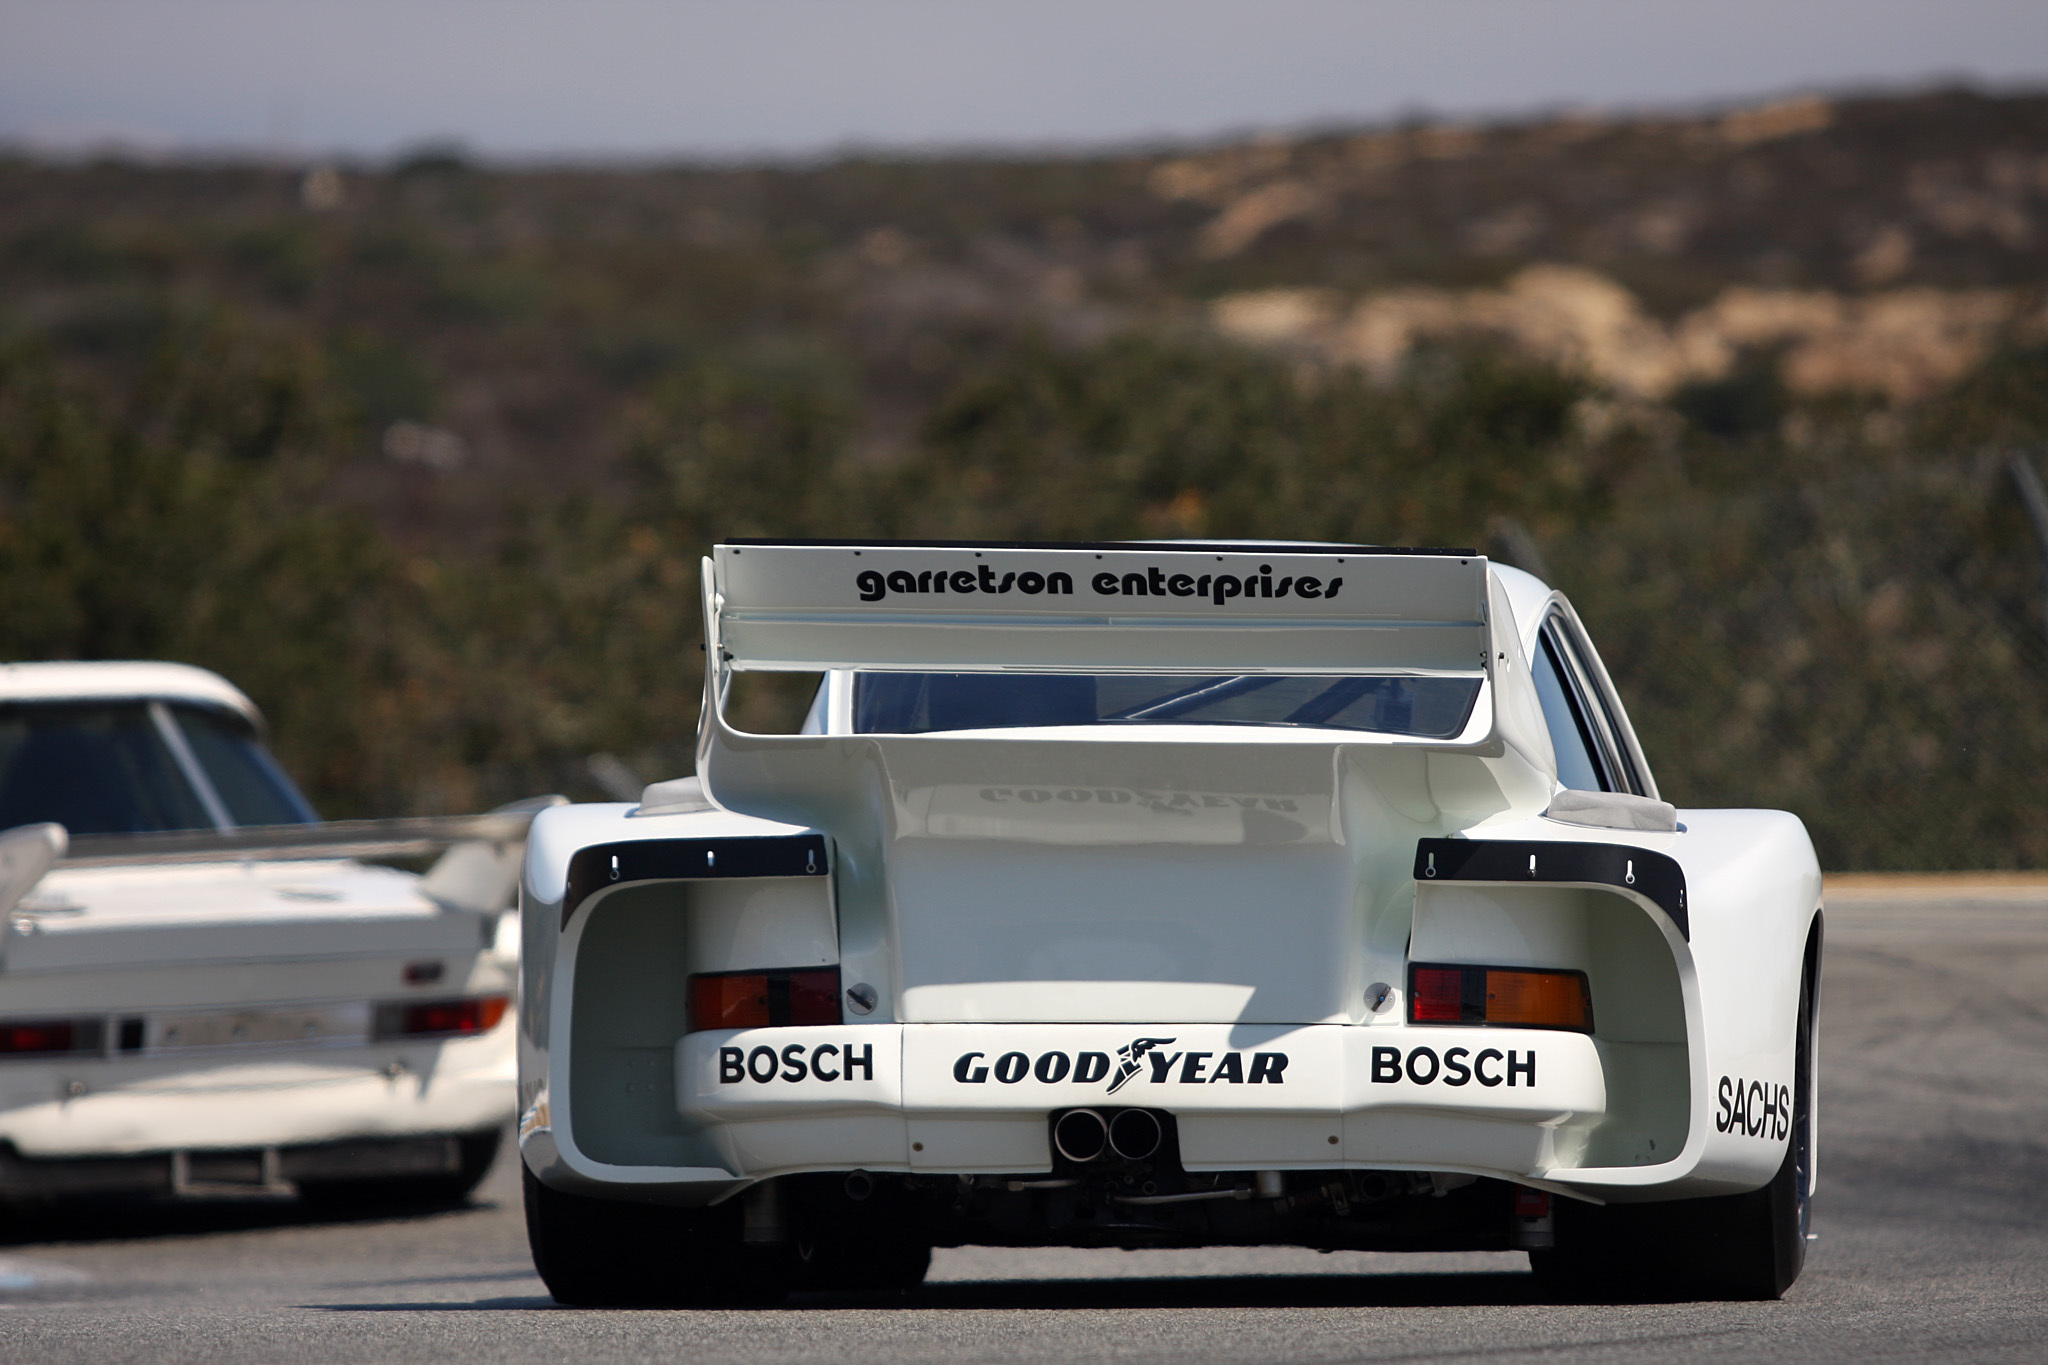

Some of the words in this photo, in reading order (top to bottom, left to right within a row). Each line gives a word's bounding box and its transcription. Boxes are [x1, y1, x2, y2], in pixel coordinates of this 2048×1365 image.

[856, 564, 1074, 602] garretson
[1091, 563, 1344, 606] enterprises
[719, 1043, 873, 1084] BOSCH
[1370, 1046, 1536, 1088] BOSCH
[1716, 1075, 1790, 1142] SACHS
